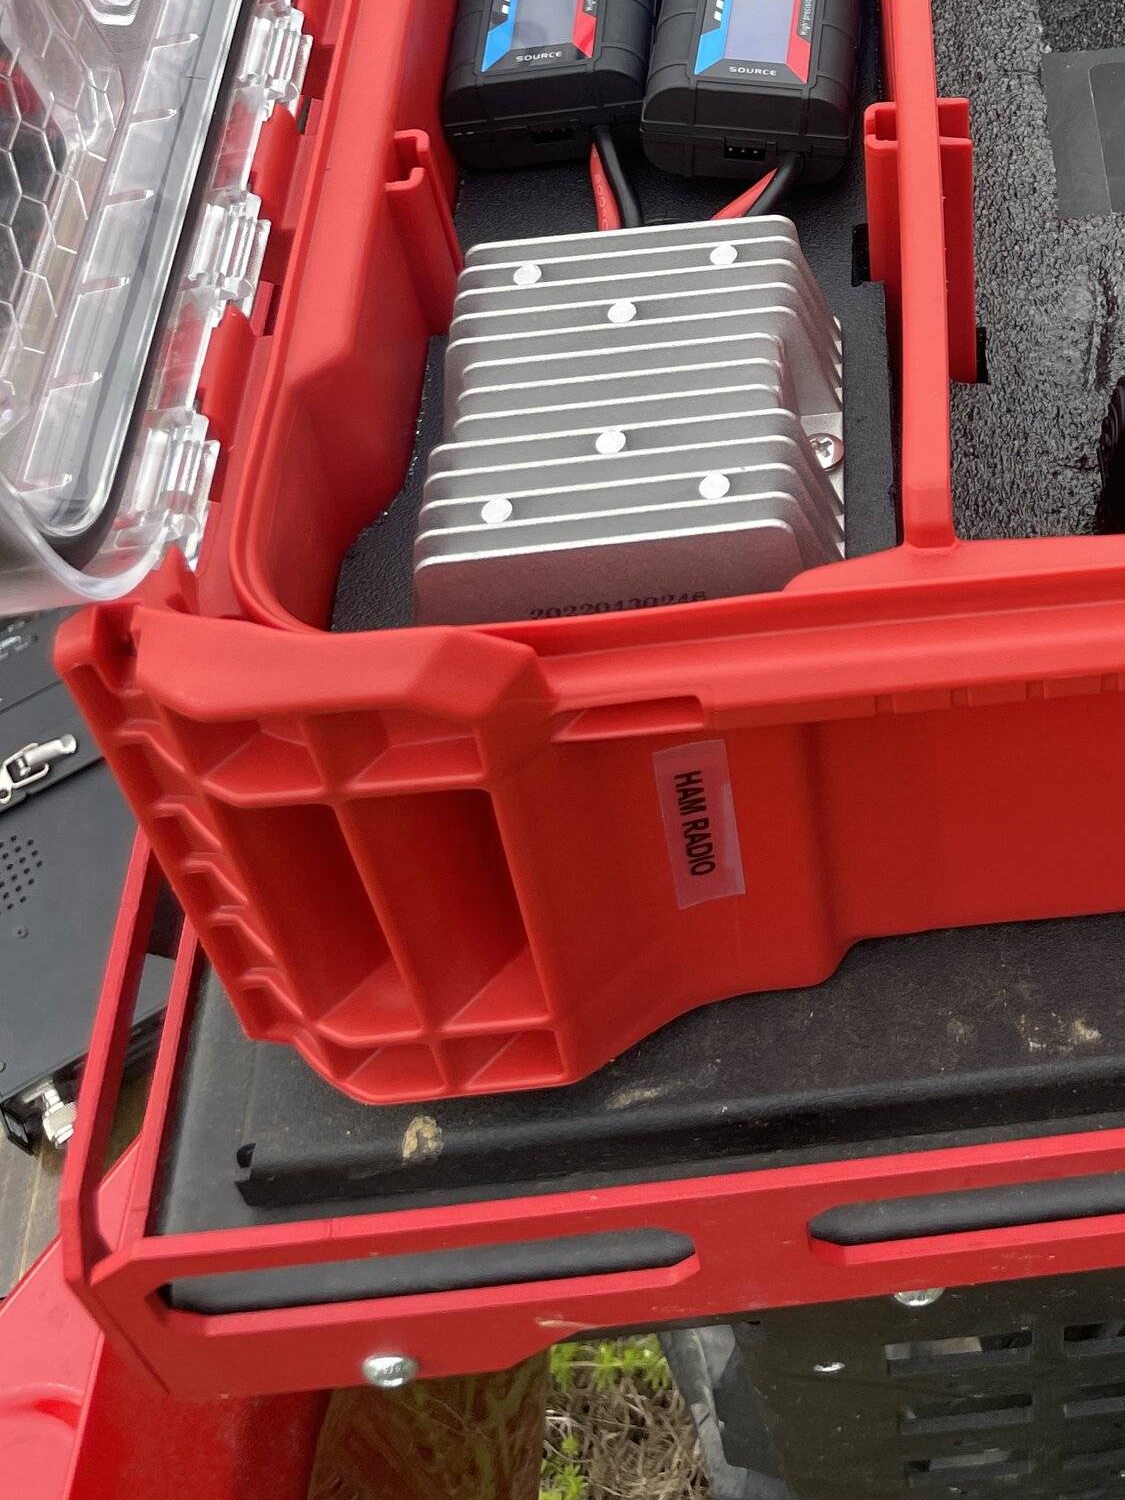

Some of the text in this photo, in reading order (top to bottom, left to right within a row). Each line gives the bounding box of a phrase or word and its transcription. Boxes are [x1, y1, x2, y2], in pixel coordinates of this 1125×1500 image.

[516, 51, 562, 63] SOURCE
[729, 66, 777, 77] SOURCE
[674, 771, 716, 876] HAM RADIO
